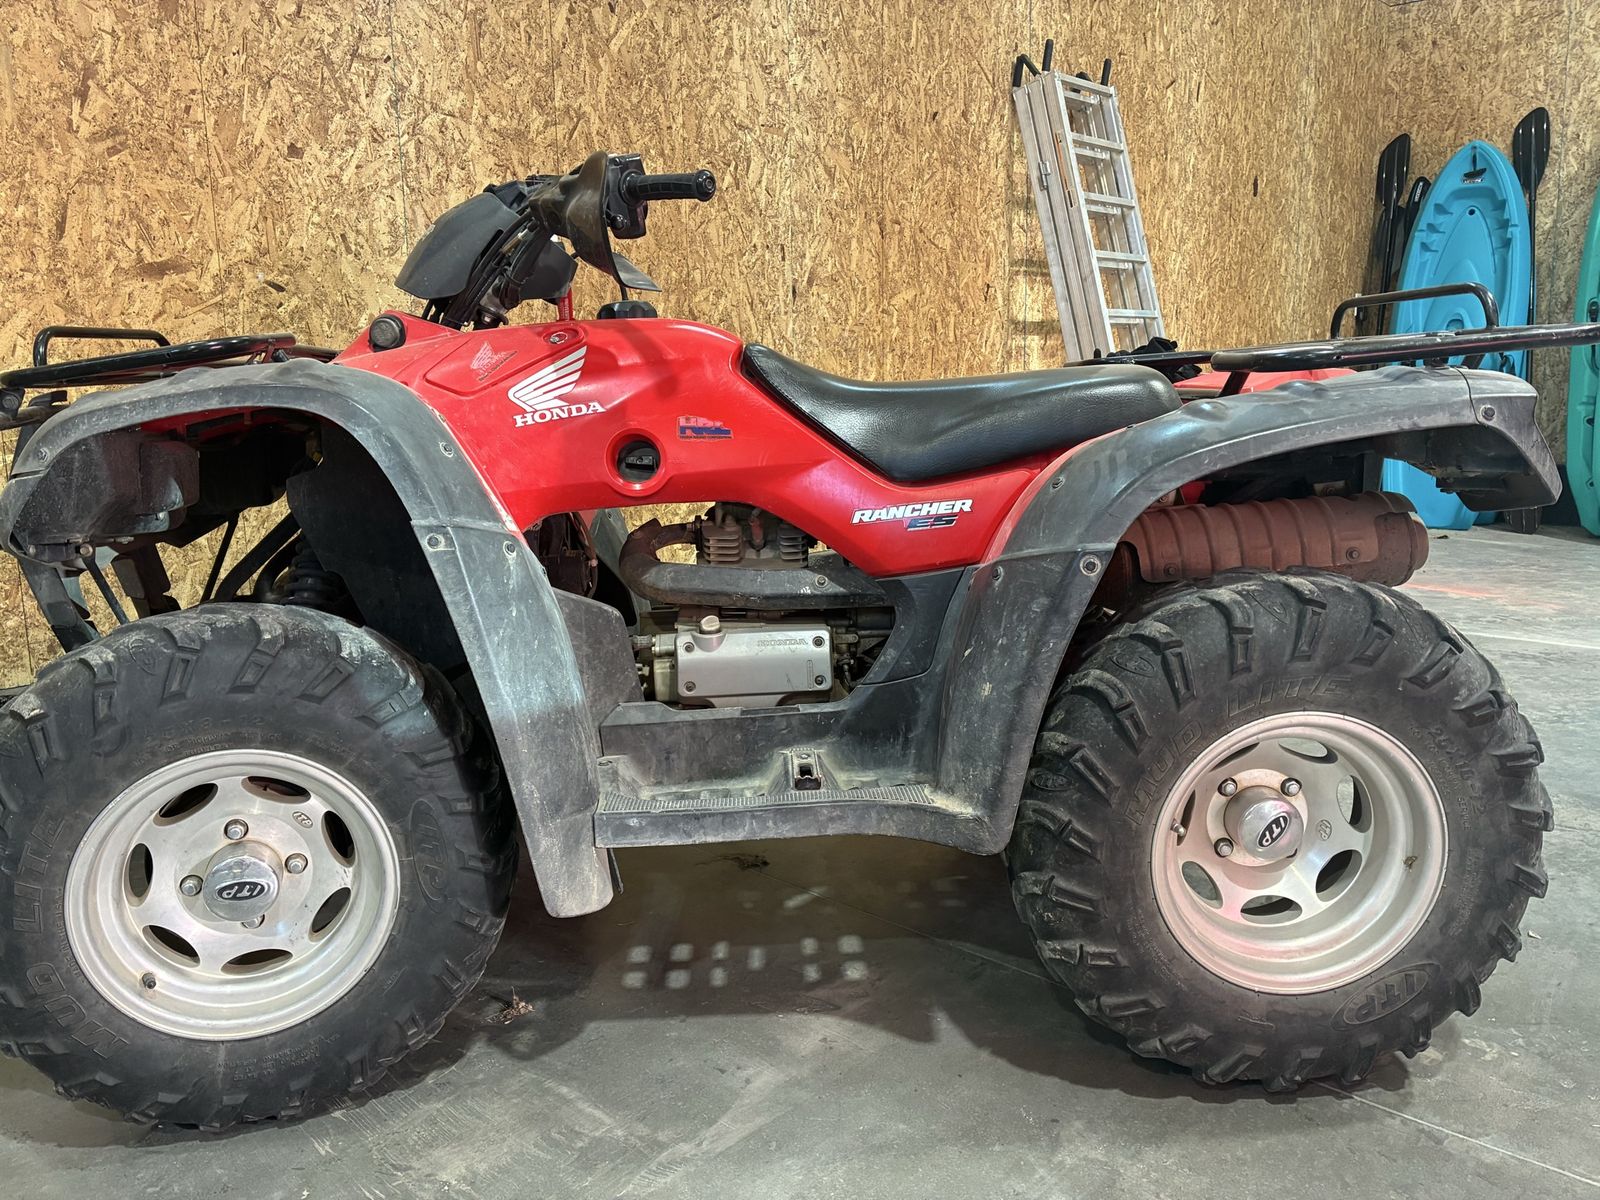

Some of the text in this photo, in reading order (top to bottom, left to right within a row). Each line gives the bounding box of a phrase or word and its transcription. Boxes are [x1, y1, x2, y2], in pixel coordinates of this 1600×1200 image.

[513, 401, 607, 427] HONDA
[851, 499, 973, 524] RANCHER
[906, 514, 958, 530] ES
[757, 638, 808, 648] HONDA
[1125, 720, 1203, 825] MUD
[1226, 675, 1352, 717] LITE
[293, 812, 313, 828] ITP
[1262, 816, 1285, 847] ITP
[1319, 820, 1331, 840] ITP
[417, 823, 446, 893] ITP
[221, 884, 262, 899] ITP
[12, 806, 130, 1059] MUD LITE
[1354, 972, 1418, 1022] ITP
